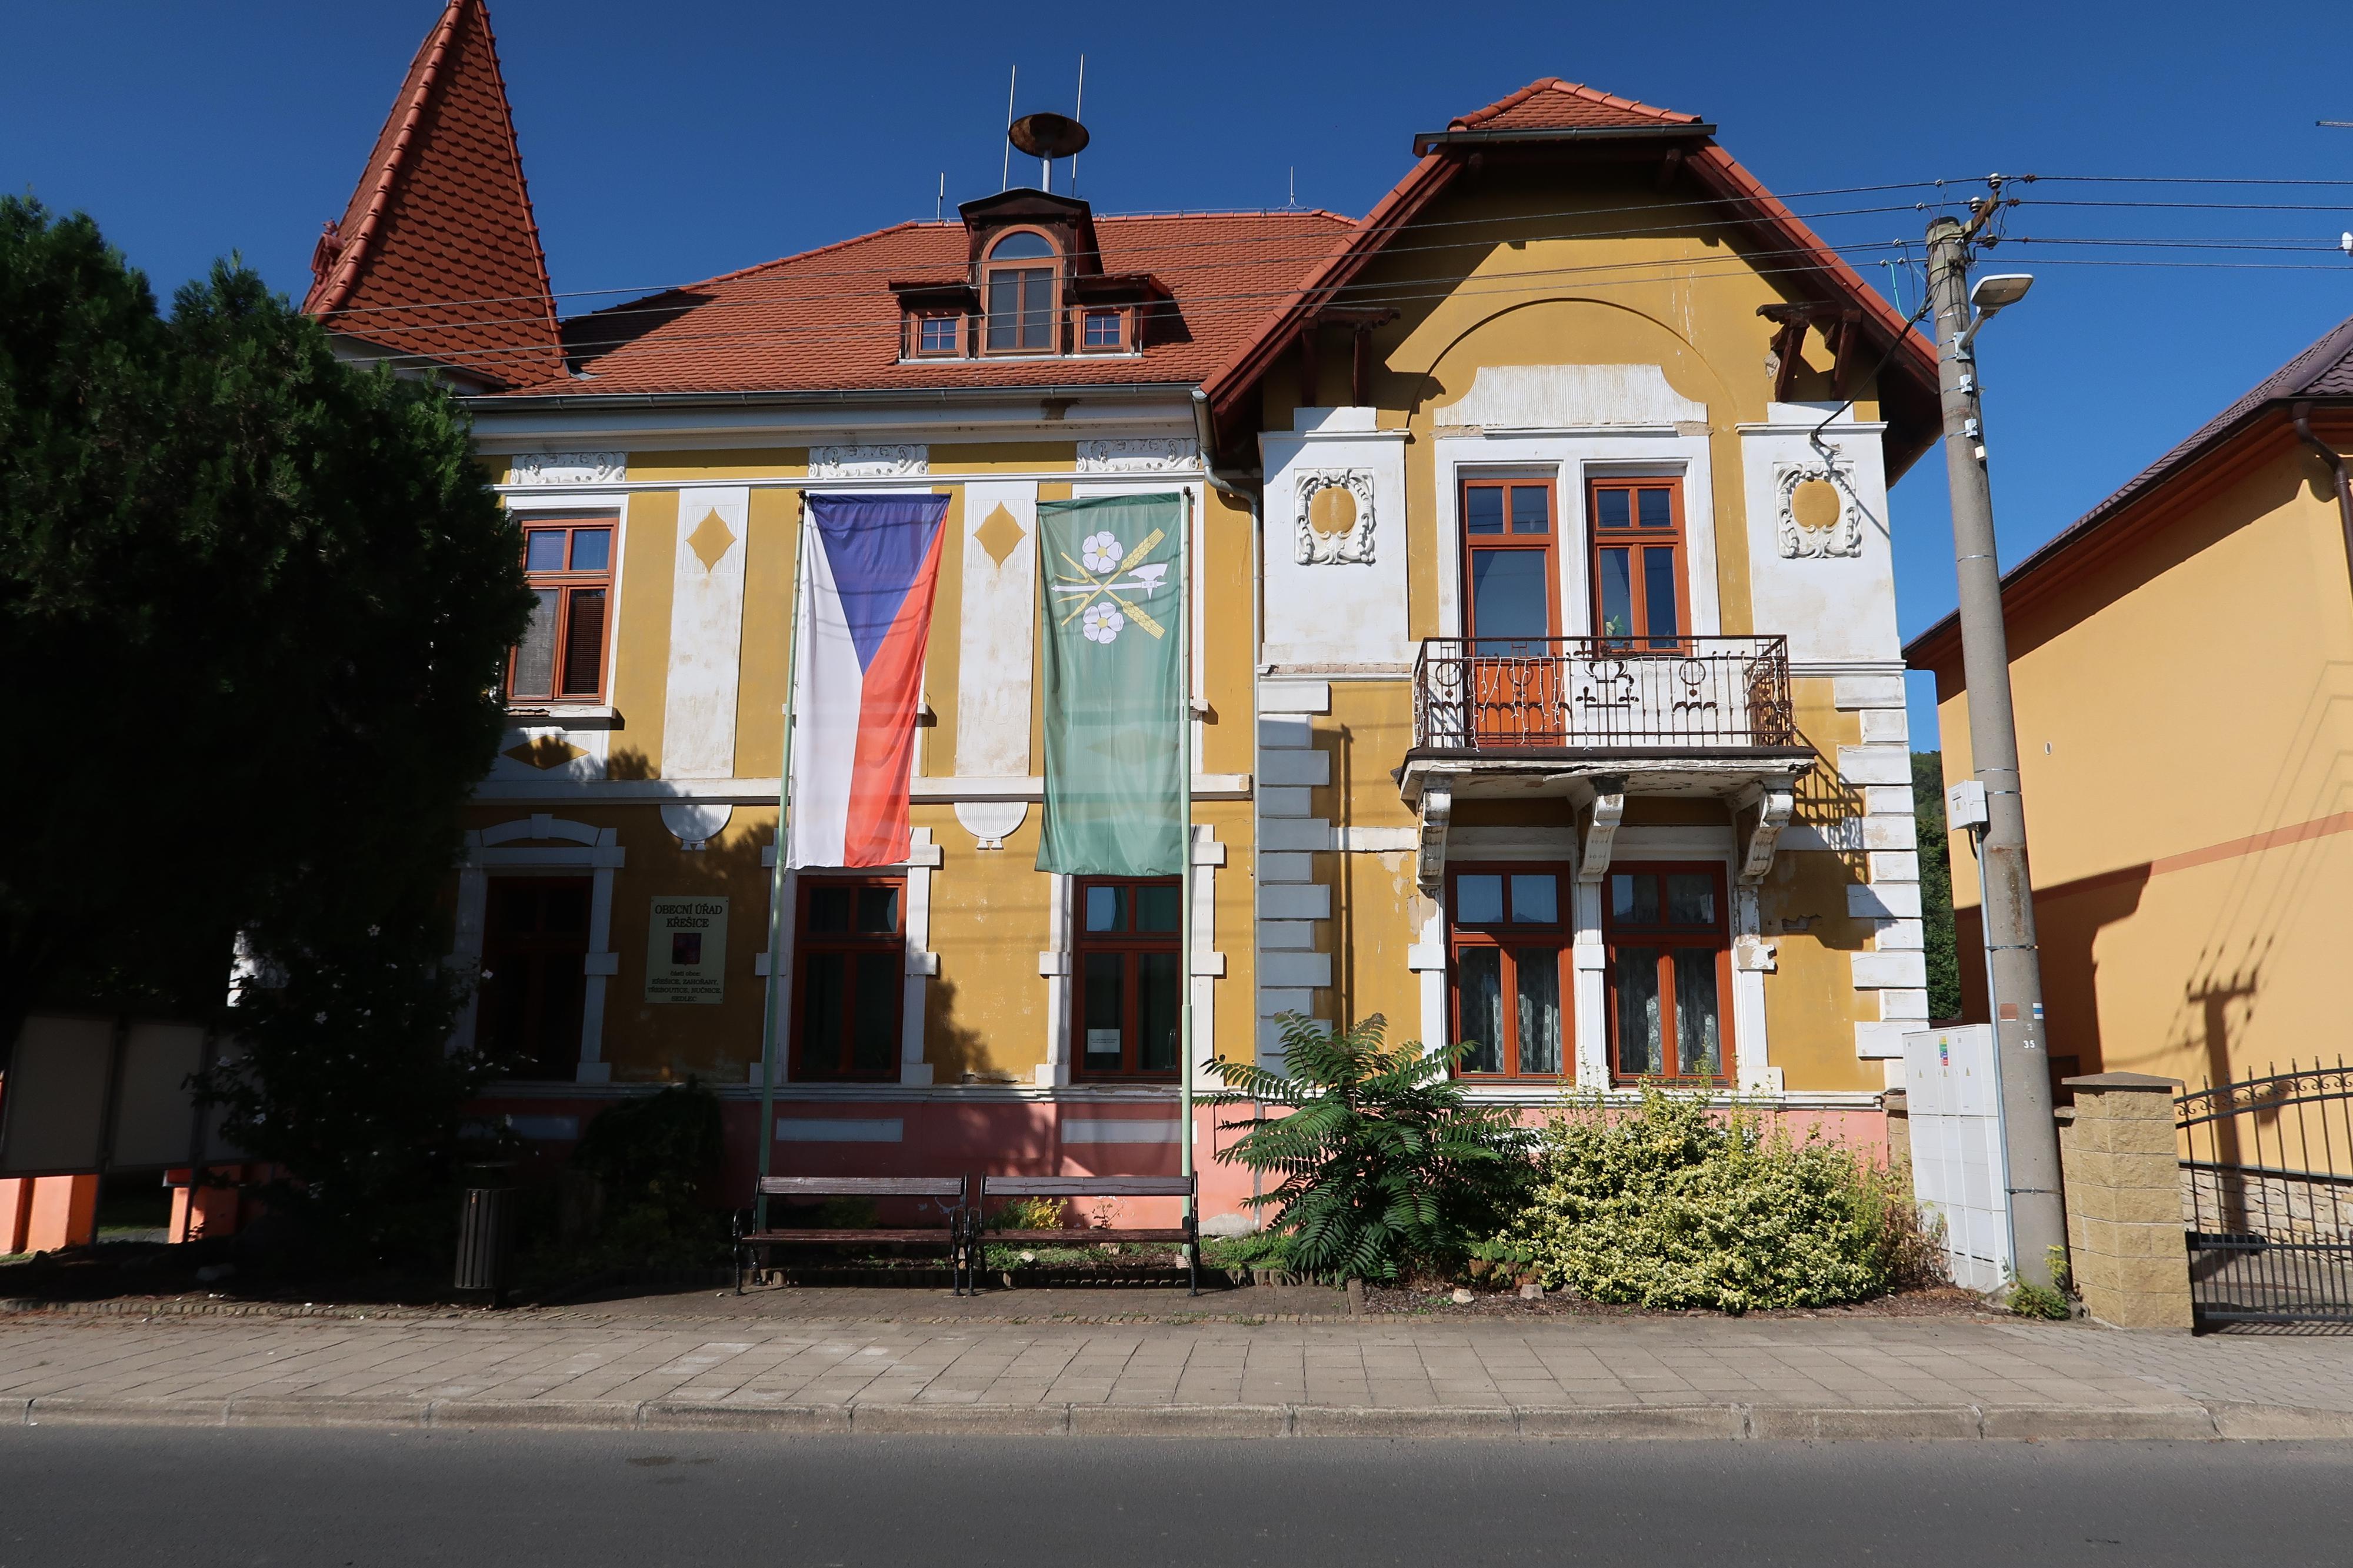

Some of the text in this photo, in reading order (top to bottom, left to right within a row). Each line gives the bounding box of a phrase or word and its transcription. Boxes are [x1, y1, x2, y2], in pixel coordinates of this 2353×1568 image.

[655, 903, 722, 915] OBECNÍ ÚŘAD
[666, 916, 709, 928] KŘEŠICE
[2023, 1039, 2035, 1049] 35
